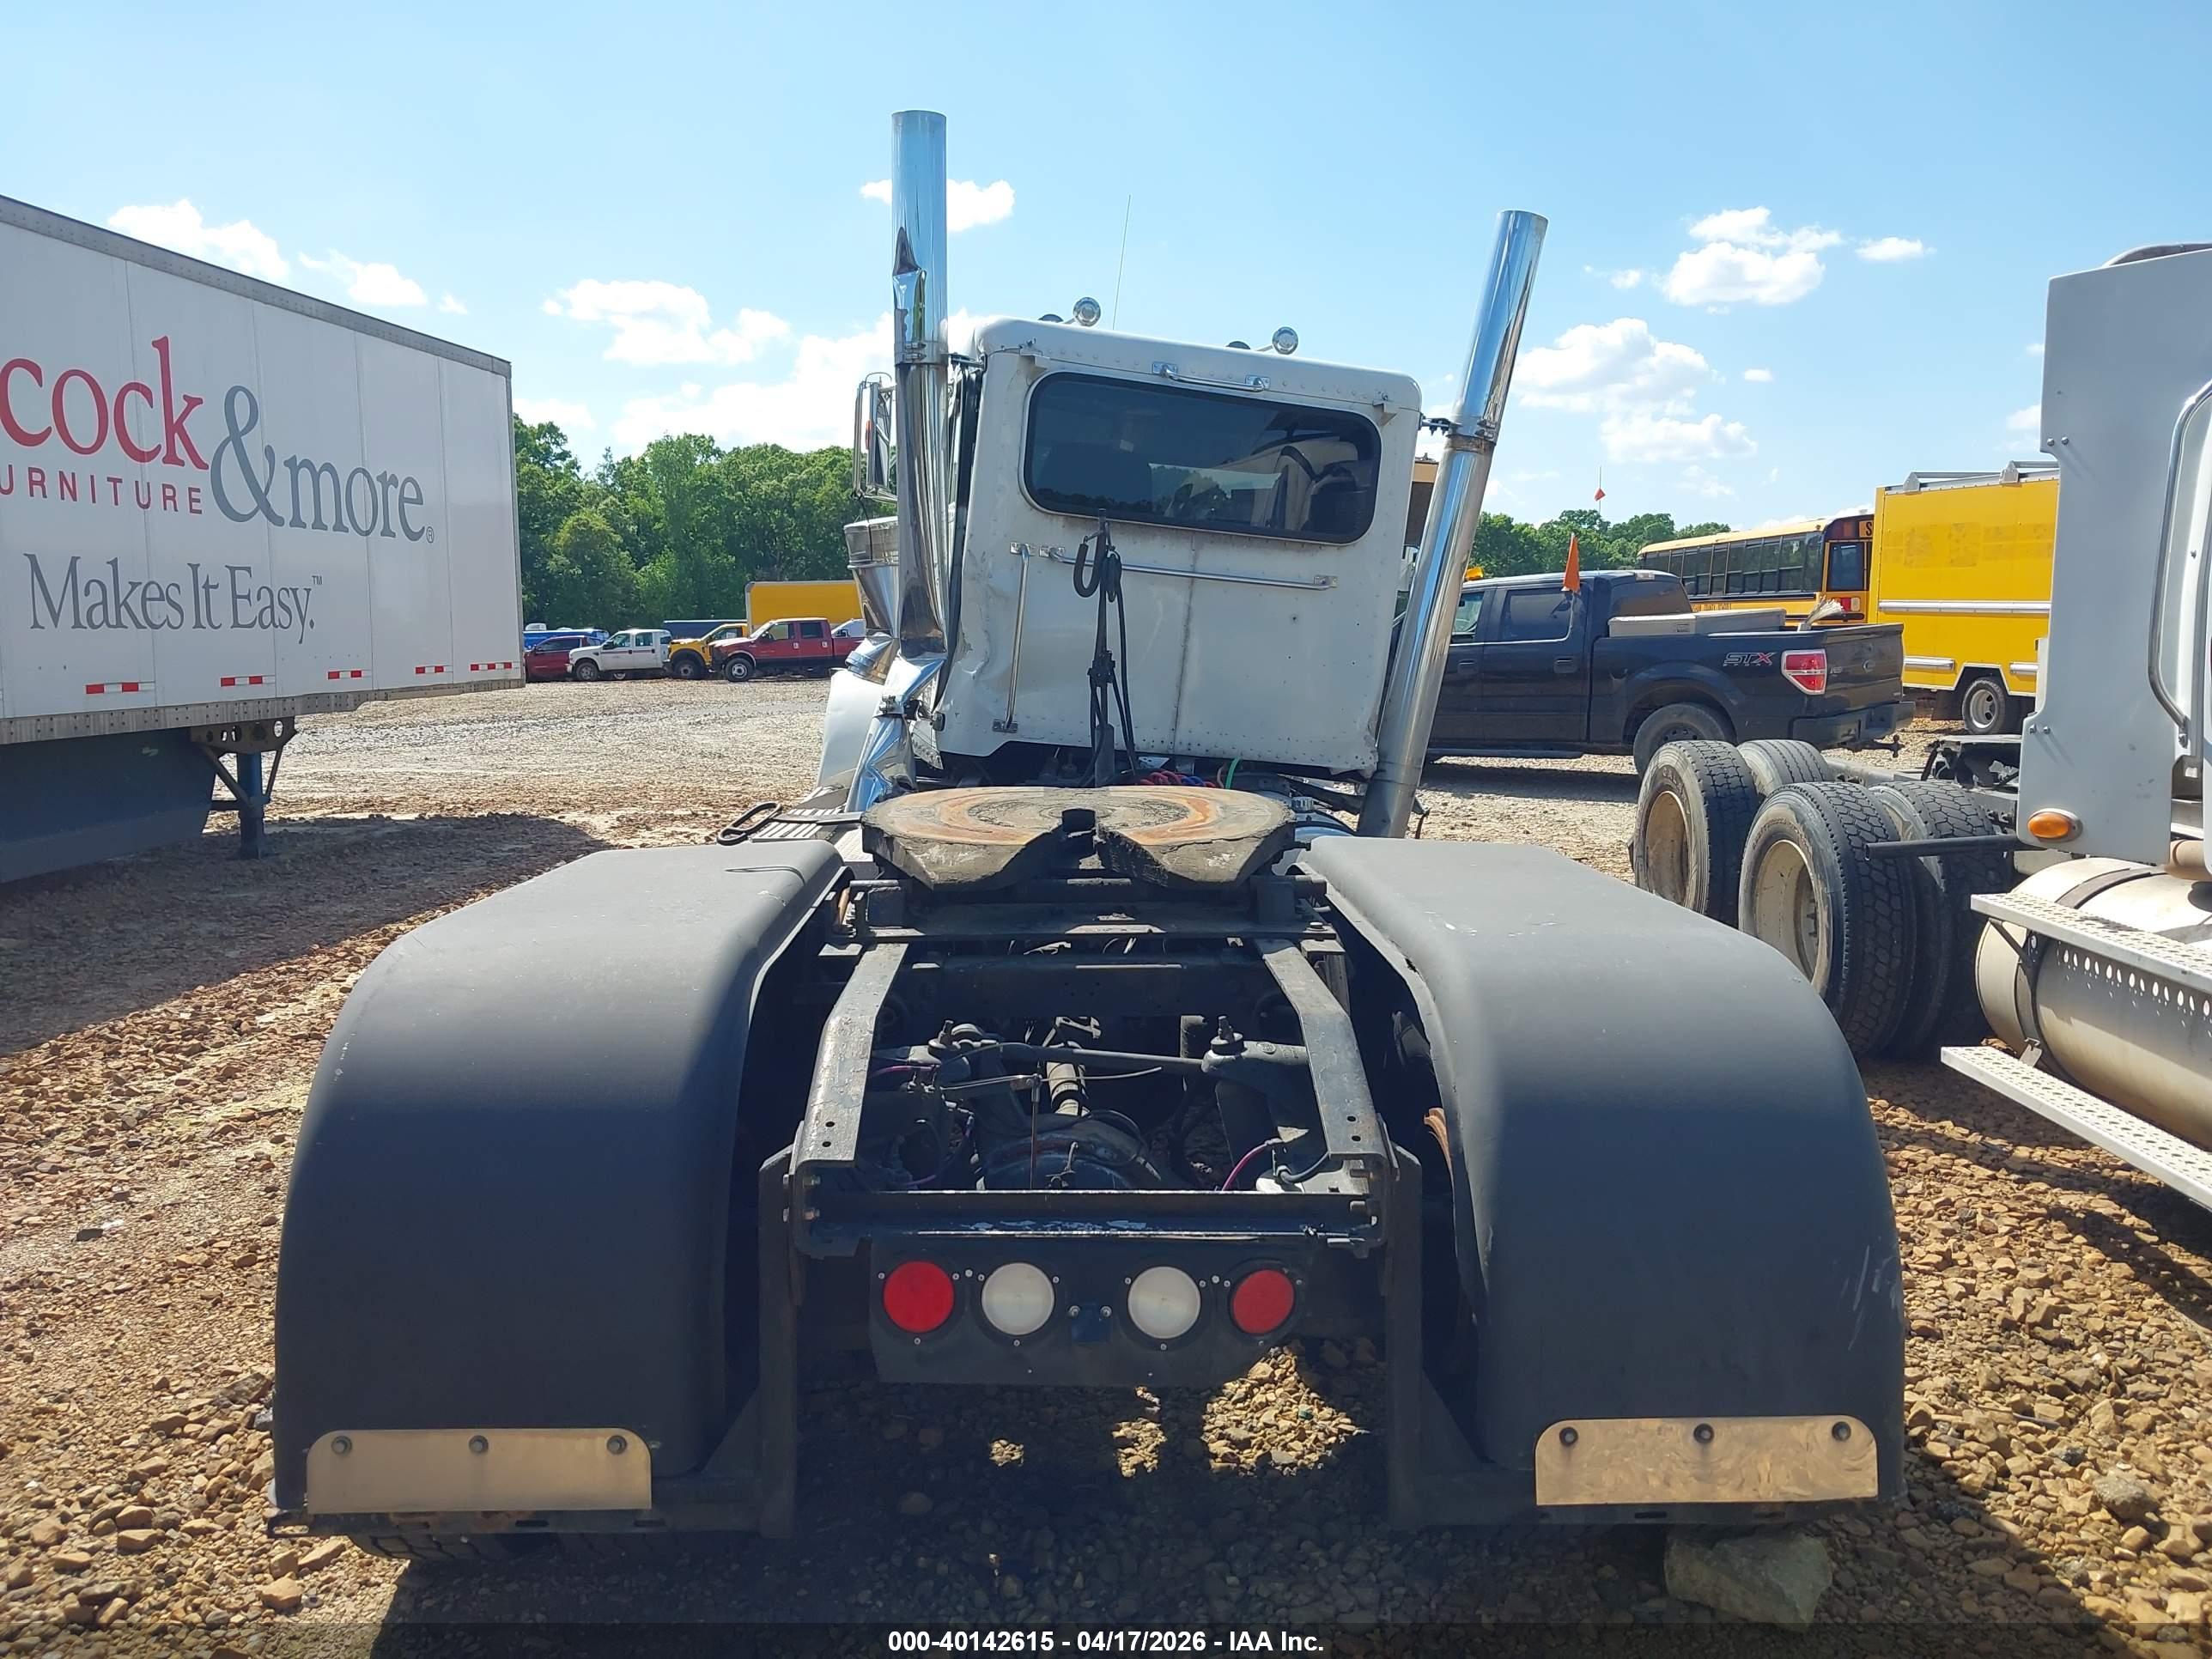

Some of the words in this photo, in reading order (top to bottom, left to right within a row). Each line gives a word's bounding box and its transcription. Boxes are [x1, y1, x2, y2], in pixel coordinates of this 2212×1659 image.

[22, 552, 185, 630] Makes
[186, 562, 222, 630] It
[1723, 652, 1778, 665] STX
